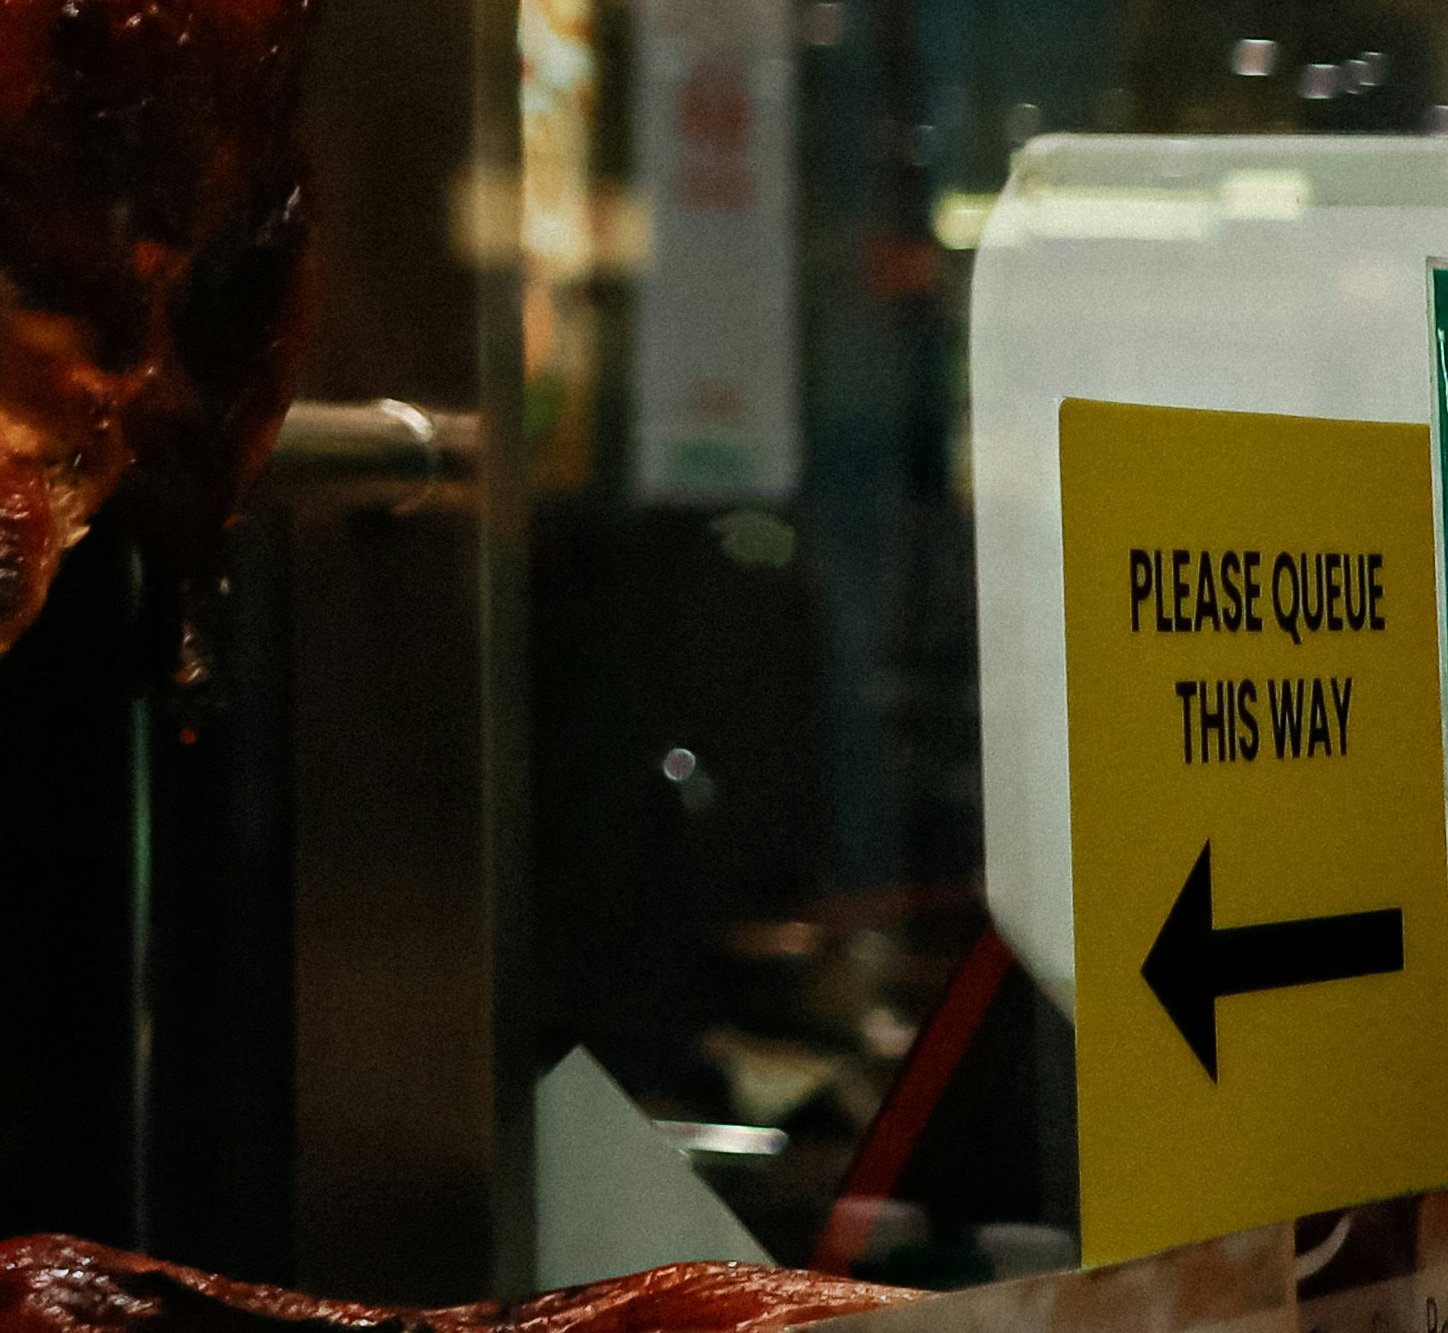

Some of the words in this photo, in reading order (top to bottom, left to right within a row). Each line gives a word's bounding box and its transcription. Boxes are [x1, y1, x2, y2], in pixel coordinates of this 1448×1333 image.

[1130, 548, 1263, 633] PLEASE
[1271, 550, 1386, 645] QUEUE
[1174, 678, 1260, 764] THIS
[1267, 676, 1353, 760] WAY
